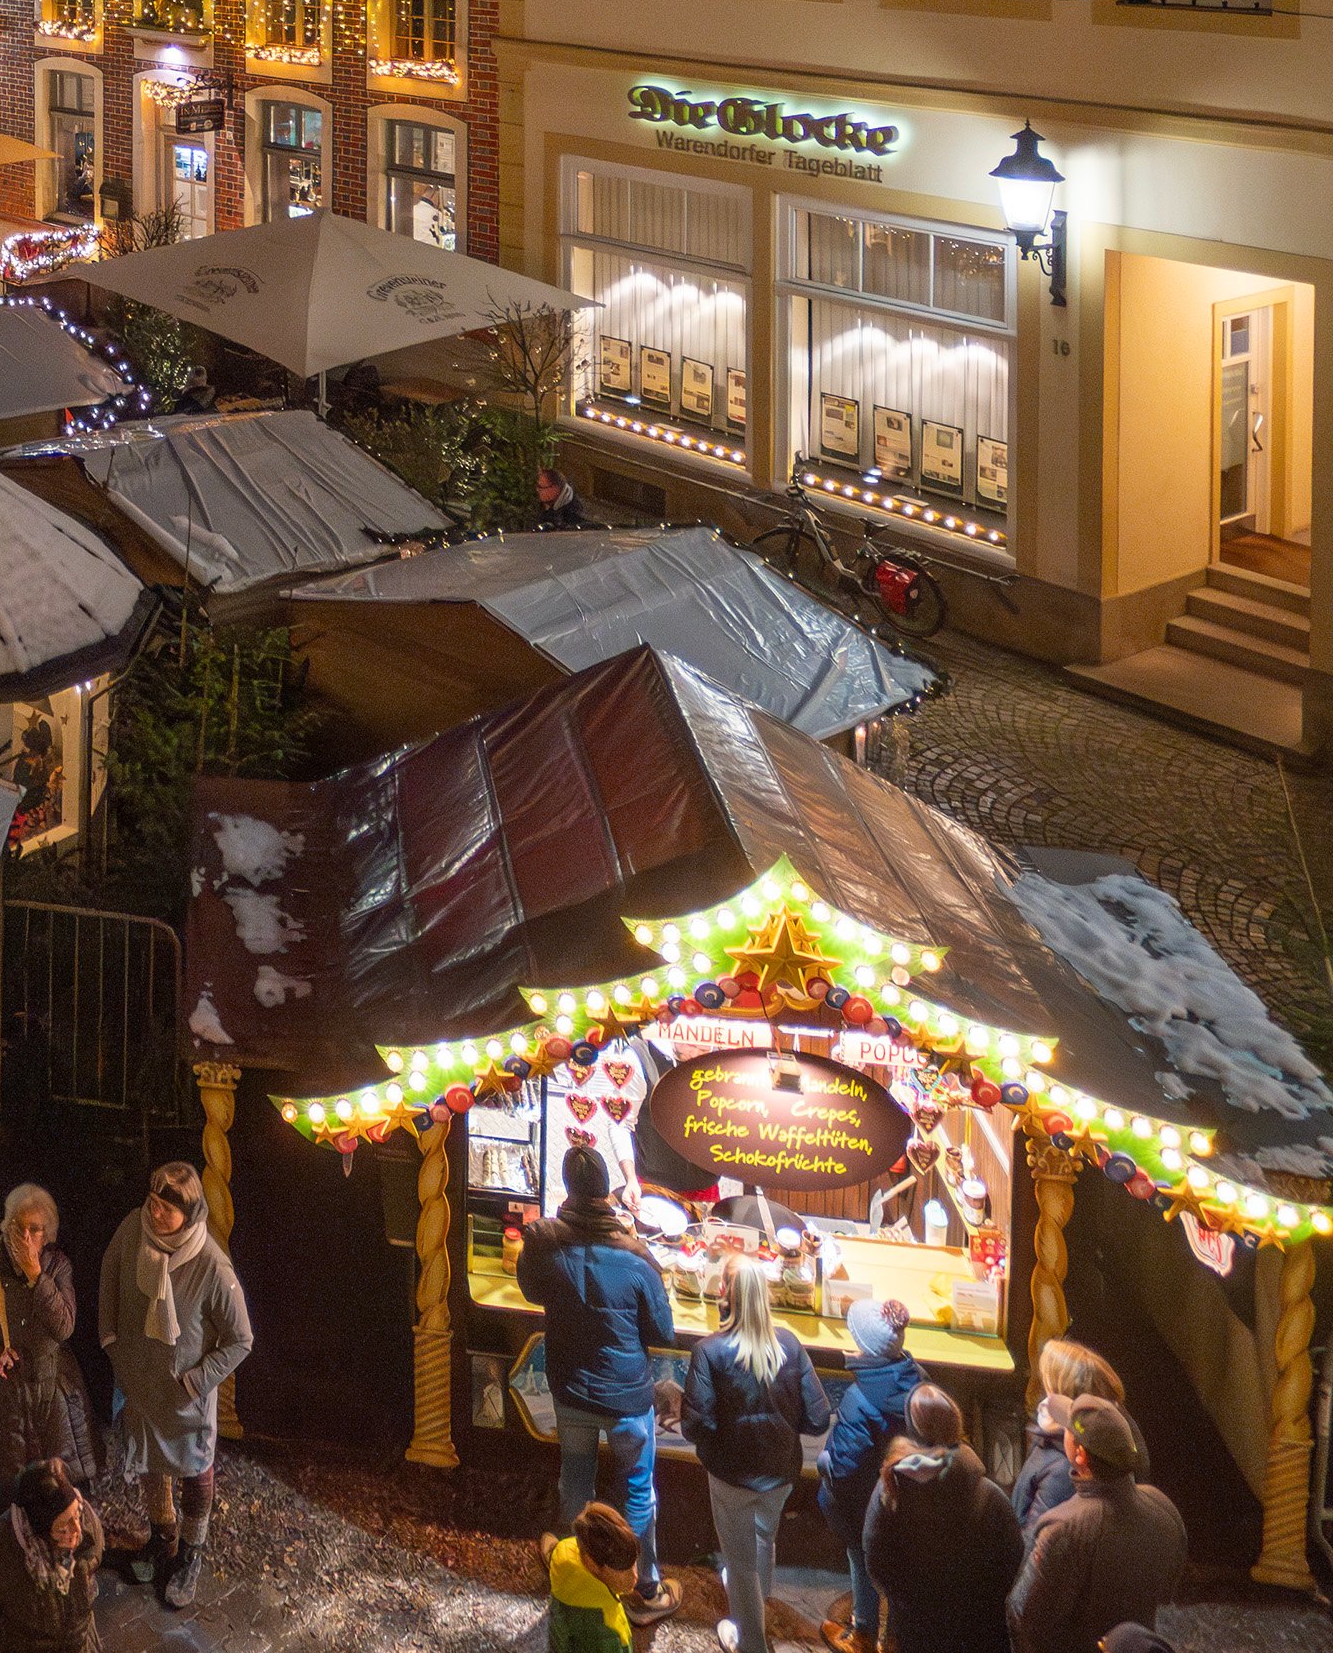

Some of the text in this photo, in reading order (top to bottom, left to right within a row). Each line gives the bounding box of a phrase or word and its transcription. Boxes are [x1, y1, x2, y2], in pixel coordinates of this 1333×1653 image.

[627, 84, 900, 157] Die Glocke
[655, 128, 884, 184] Warendorfer Tageblatt
[366, 274, 447, 302] Grevensteiner
[1052, 338, 1071, 357] 16
[658, 1021, 756, 1048] MANDELN
[696, 1089, 861, 1128] Popcorn, Crepes,
[683, 1114, 873, 1156] frische Waffeltüten,
[709, 1144, 848, 1175] Schokofrüchte
